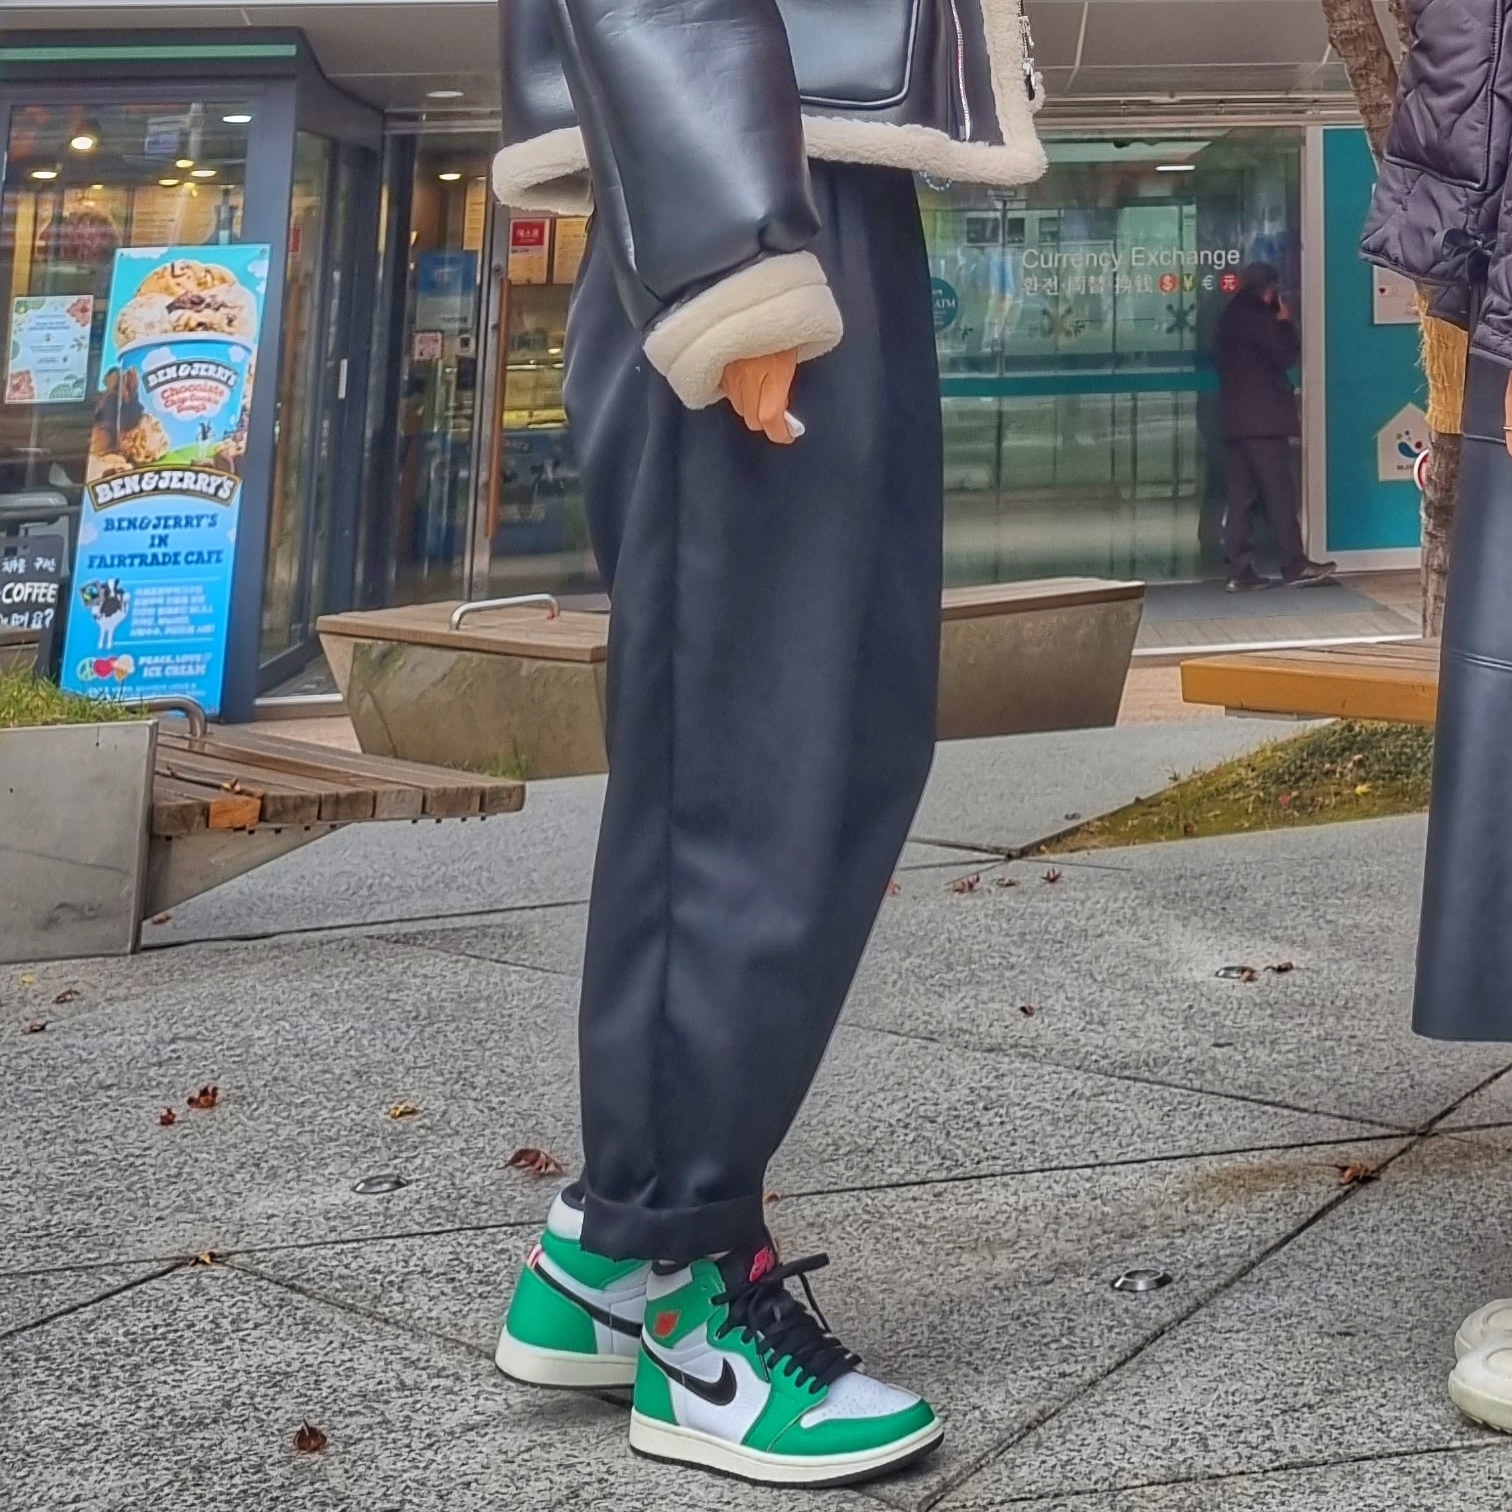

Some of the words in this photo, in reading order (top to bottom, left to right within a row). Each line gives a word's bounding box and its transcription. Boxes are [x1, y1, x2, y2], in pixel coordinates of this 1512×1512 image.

[1022, 248, 1123, 272] Currency
[1131, 246, 1241, 271] Exchange
[96, 469, 235, 505] BEN&JERRY'S
[103, 513, 219, 533] BEN&JERRY'S
[148, 534, 169, 549] IN
[87, 552, 182, 570] FAIRTRADE
[184, 549, 224, 565] CAFE
[1, 581, 59, 604] COFFEE
